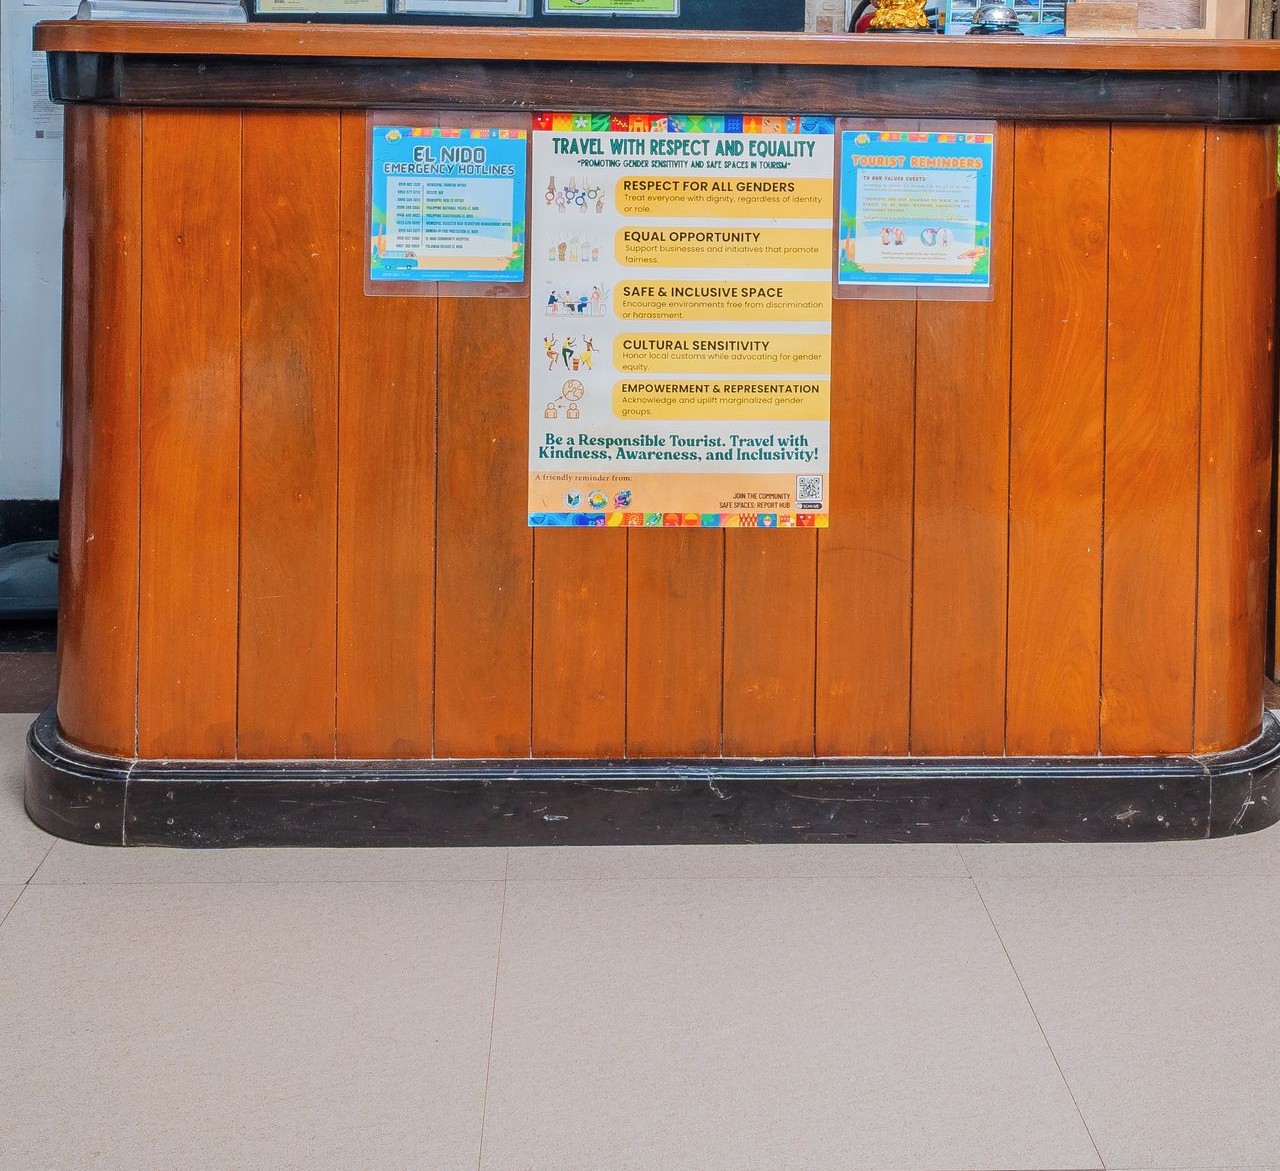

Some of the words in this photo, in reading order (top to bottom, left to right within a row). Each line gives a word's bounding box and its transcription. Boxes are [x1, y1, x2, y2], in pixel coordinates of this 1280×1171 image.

[552, 137, 604, 155] TRAVEL
[610, 138, 645, 155] WITH
[650, 139, 710, 156] RESPECT
[715, 139, 744, 157] AND
[749, 140, 816, 158] EQUALITY
[413, 146, 435, 163] EL
[441, 147, 485, 164] NIDO
[622, 159, 649, 168] GENDER
[651, 159, 688, 168] SENSITIVITY
[690, 160, 704, 169] AND
[706, 160, 722, 169] SAFE
[724, 161, 748, 169] SPACES
[750, 161, 757, 169] IN
[851, 155, 906, 168] TOURIST
[910, 156, 983, 170] REMINDERS
[384, 163, 454, 174] EMERGENCY
[458, 164, 515, 175] HOTLINES
[624, 181, 680, 191] RESPECT
[683, 181, 708, 191] FOR
[711, 181, 733, 192] ALL
[736, 182, 795, 192] GENDERS
[624, 193, 645, 201] Treat
[647, 195, 686, 203] everyone
[738, 195, 780, 205] regardless
[782, 195, 790, 203] of
[792, 195, 822, 204] identity
[624, 231, 666, 243] EQUAL
[669, 231, 760, 242] OPPORTUNITY
[625, 244, 658, 254] Support
[659, 245, 705, 253] businesses
[724, 245, 764, 253] initiatives
[784, 247, 819, 255] promote
[623, 286, 654, 297] SAFE
[658, 287, 668, 297] &
[671, 287, 738, 297] INCLUSIVE
[741, 287, 783, 298] SPACE
[622, 300, 667, 310] Encourage
[668, 301, 725, 309] environments
[726, 301, 743, 309] free
[744, 301, 764, 309] from
[765, 301, 824, 309] discrimination
[623, 339, 689, 351] CULTURAL
[692, 340, 770, 351] SENSITIVITY
[670, 352, 706, 360] customs
[730, 353, 778, 363] advocating
[779, 353, 791, 361] for
[792, 353, 822, 363] gender
[622, 383, 710, 393] EMPOWERMENT
[712, 384, 721, 393] &
[724, 384, 819, 393] REPRESENTATION
[622, 396, 677, 406] Acknowledge
[696, 396, 718, 405] uplift
[719, 397, 773, 406] marginalized
[774, 397, 804, 406] gender
[545, 433, 563, 447] Be
[566, 437, 575, 447] a
[578, 433, 666, 449] Responsible
[669, 434, 726, 447] Tourist.
[729, 434, 774, 447] Travel
[777, 434, 809, 447] with
[539, 445, 612, 461] Kindness,
[615, 446, 702, 462] Awareness,
[706, 446, 733, 461] and
[736, 447, 818, 463] Inclusivity!
[543, 473, 573, 483] friendly
